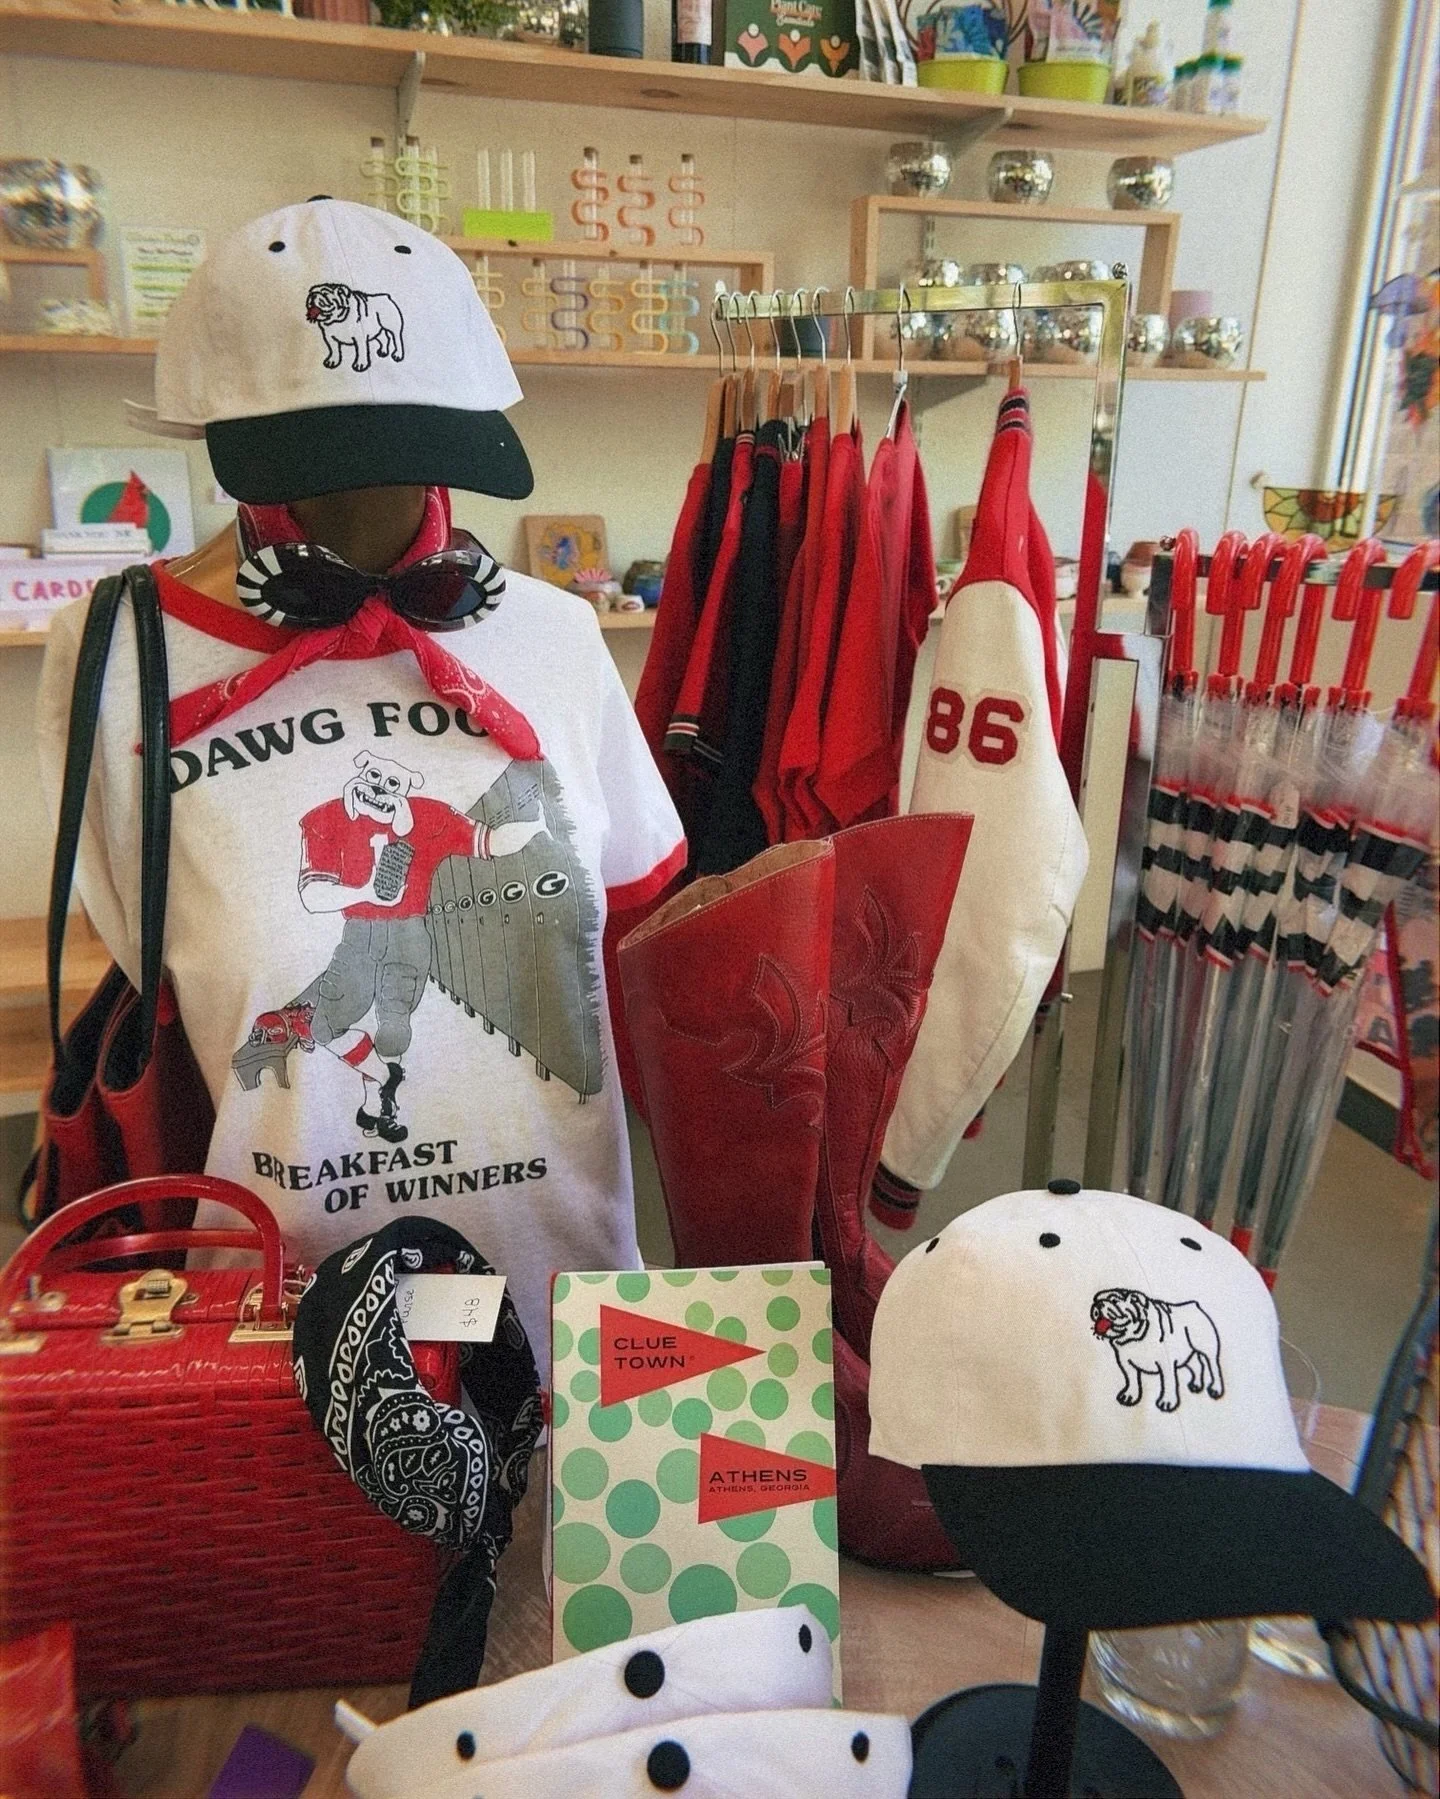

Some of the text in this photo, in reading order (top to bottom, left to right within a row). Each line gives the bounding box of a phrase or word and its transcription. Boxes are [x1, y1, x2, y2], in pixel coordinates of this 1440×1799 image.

[926, 686, 1025, 766] 86
[169, 701, 490, 794] DAWG FOO
[536, 873, 567, 895] G
[252, 1139, 458, 1190] BREAKFAST
[324, 1157, 548, 1213] OF WINNERS
[459, 1297, 480, 1328] $48
[614, 1336, 677, 1351] CLUE
[709, 1469, 808, 1484] ATHENS
[709, 1484, 810, 1493] ATHENS, GEORGIA
